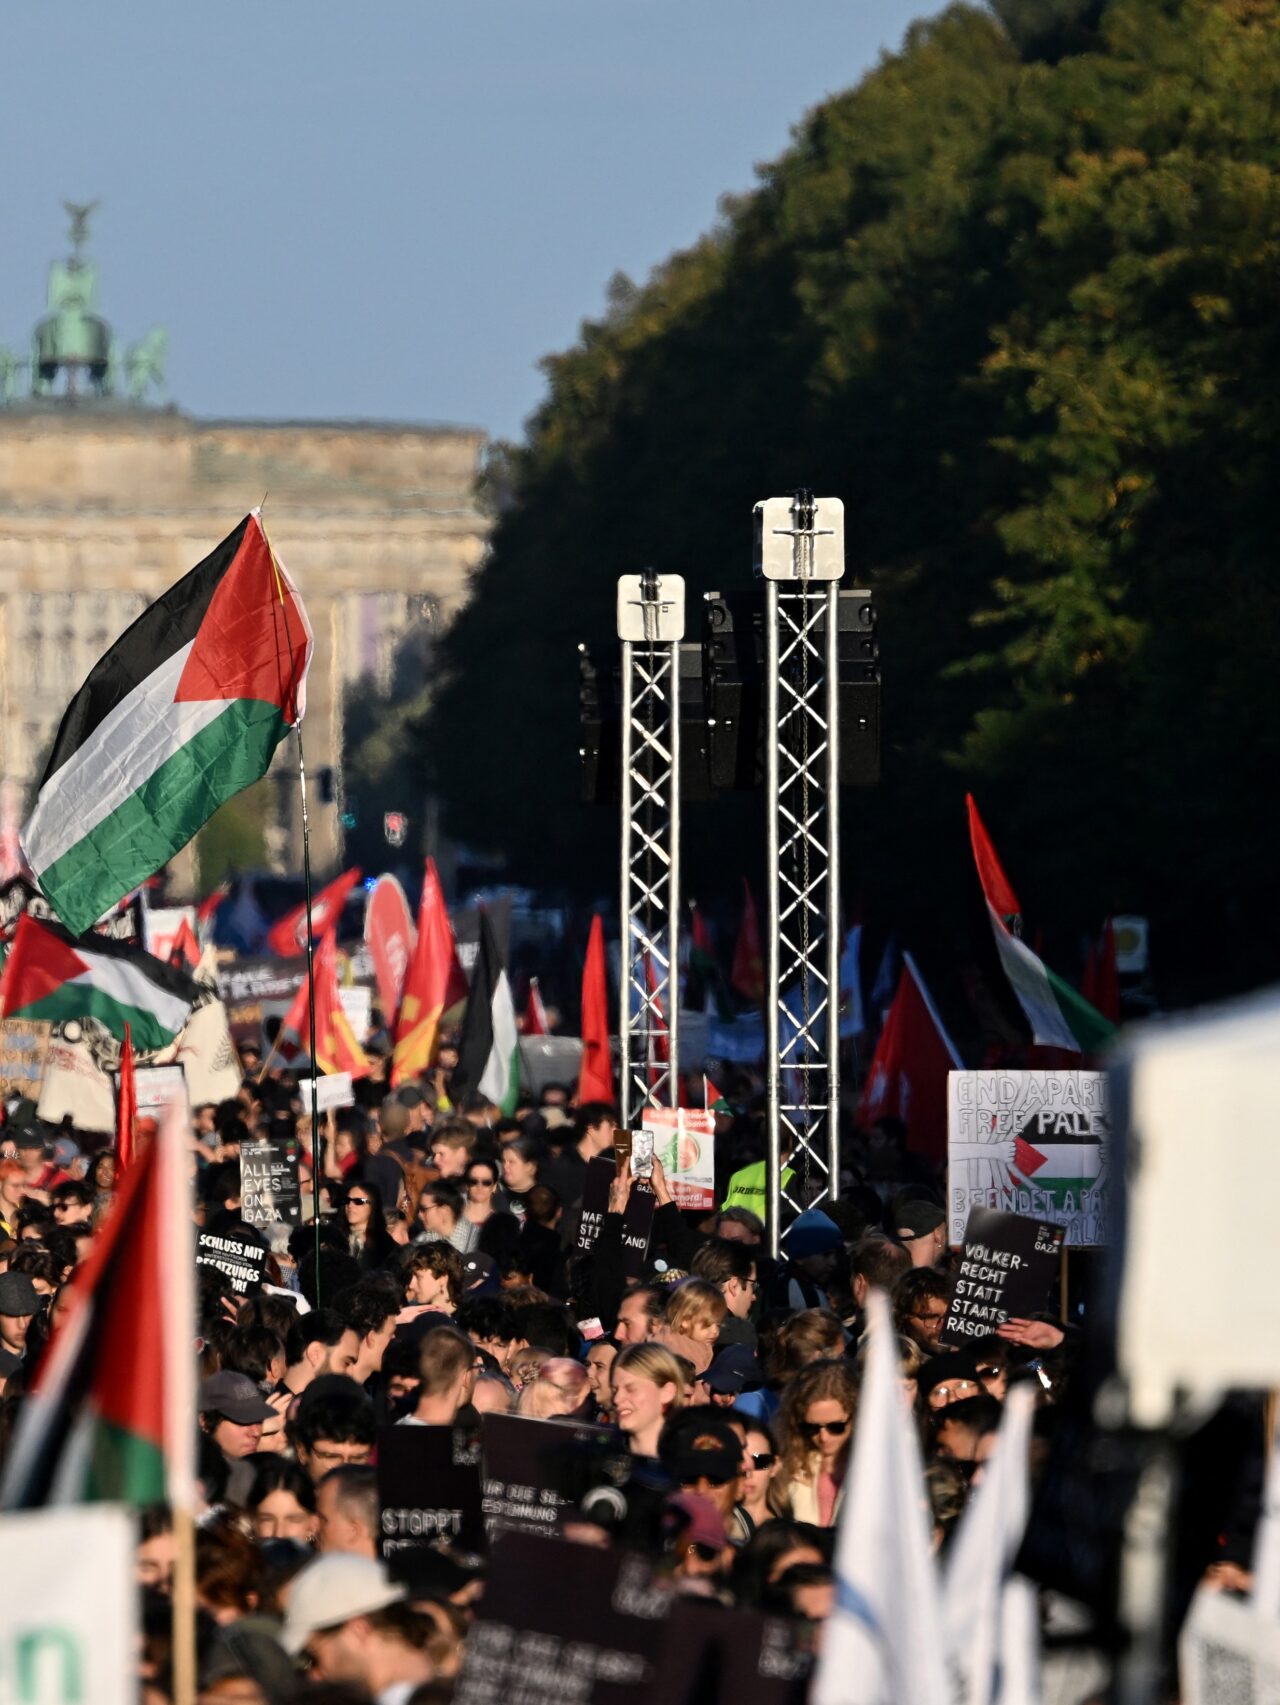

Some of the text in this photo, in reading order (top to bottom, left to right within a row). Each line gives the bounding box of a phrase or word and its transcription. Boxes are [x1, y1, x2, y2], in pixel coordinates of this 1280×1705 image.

[957, 1077, 1017, 1105] END
[959, 1109, 1026, 1134] FREE
[243, 1163, 270, 1177] ALL
[244, 1178, 281, 1193] EYES
[244, 1194, 263, 1208] ON
[244, 1208, 283, 1223] GAZA
[199, 1234, 265, 1260] SCHLUSS MIT
[965, 1243, 1028, 1270] VÖLKER-
[1034, 1241, 1058, 1254] GAZA
[960, 1262, 1007, 1285] RECHT
[955, 1280, 1003, 1303] STATT
[381, 1508, 464, 1536] STOPPT
